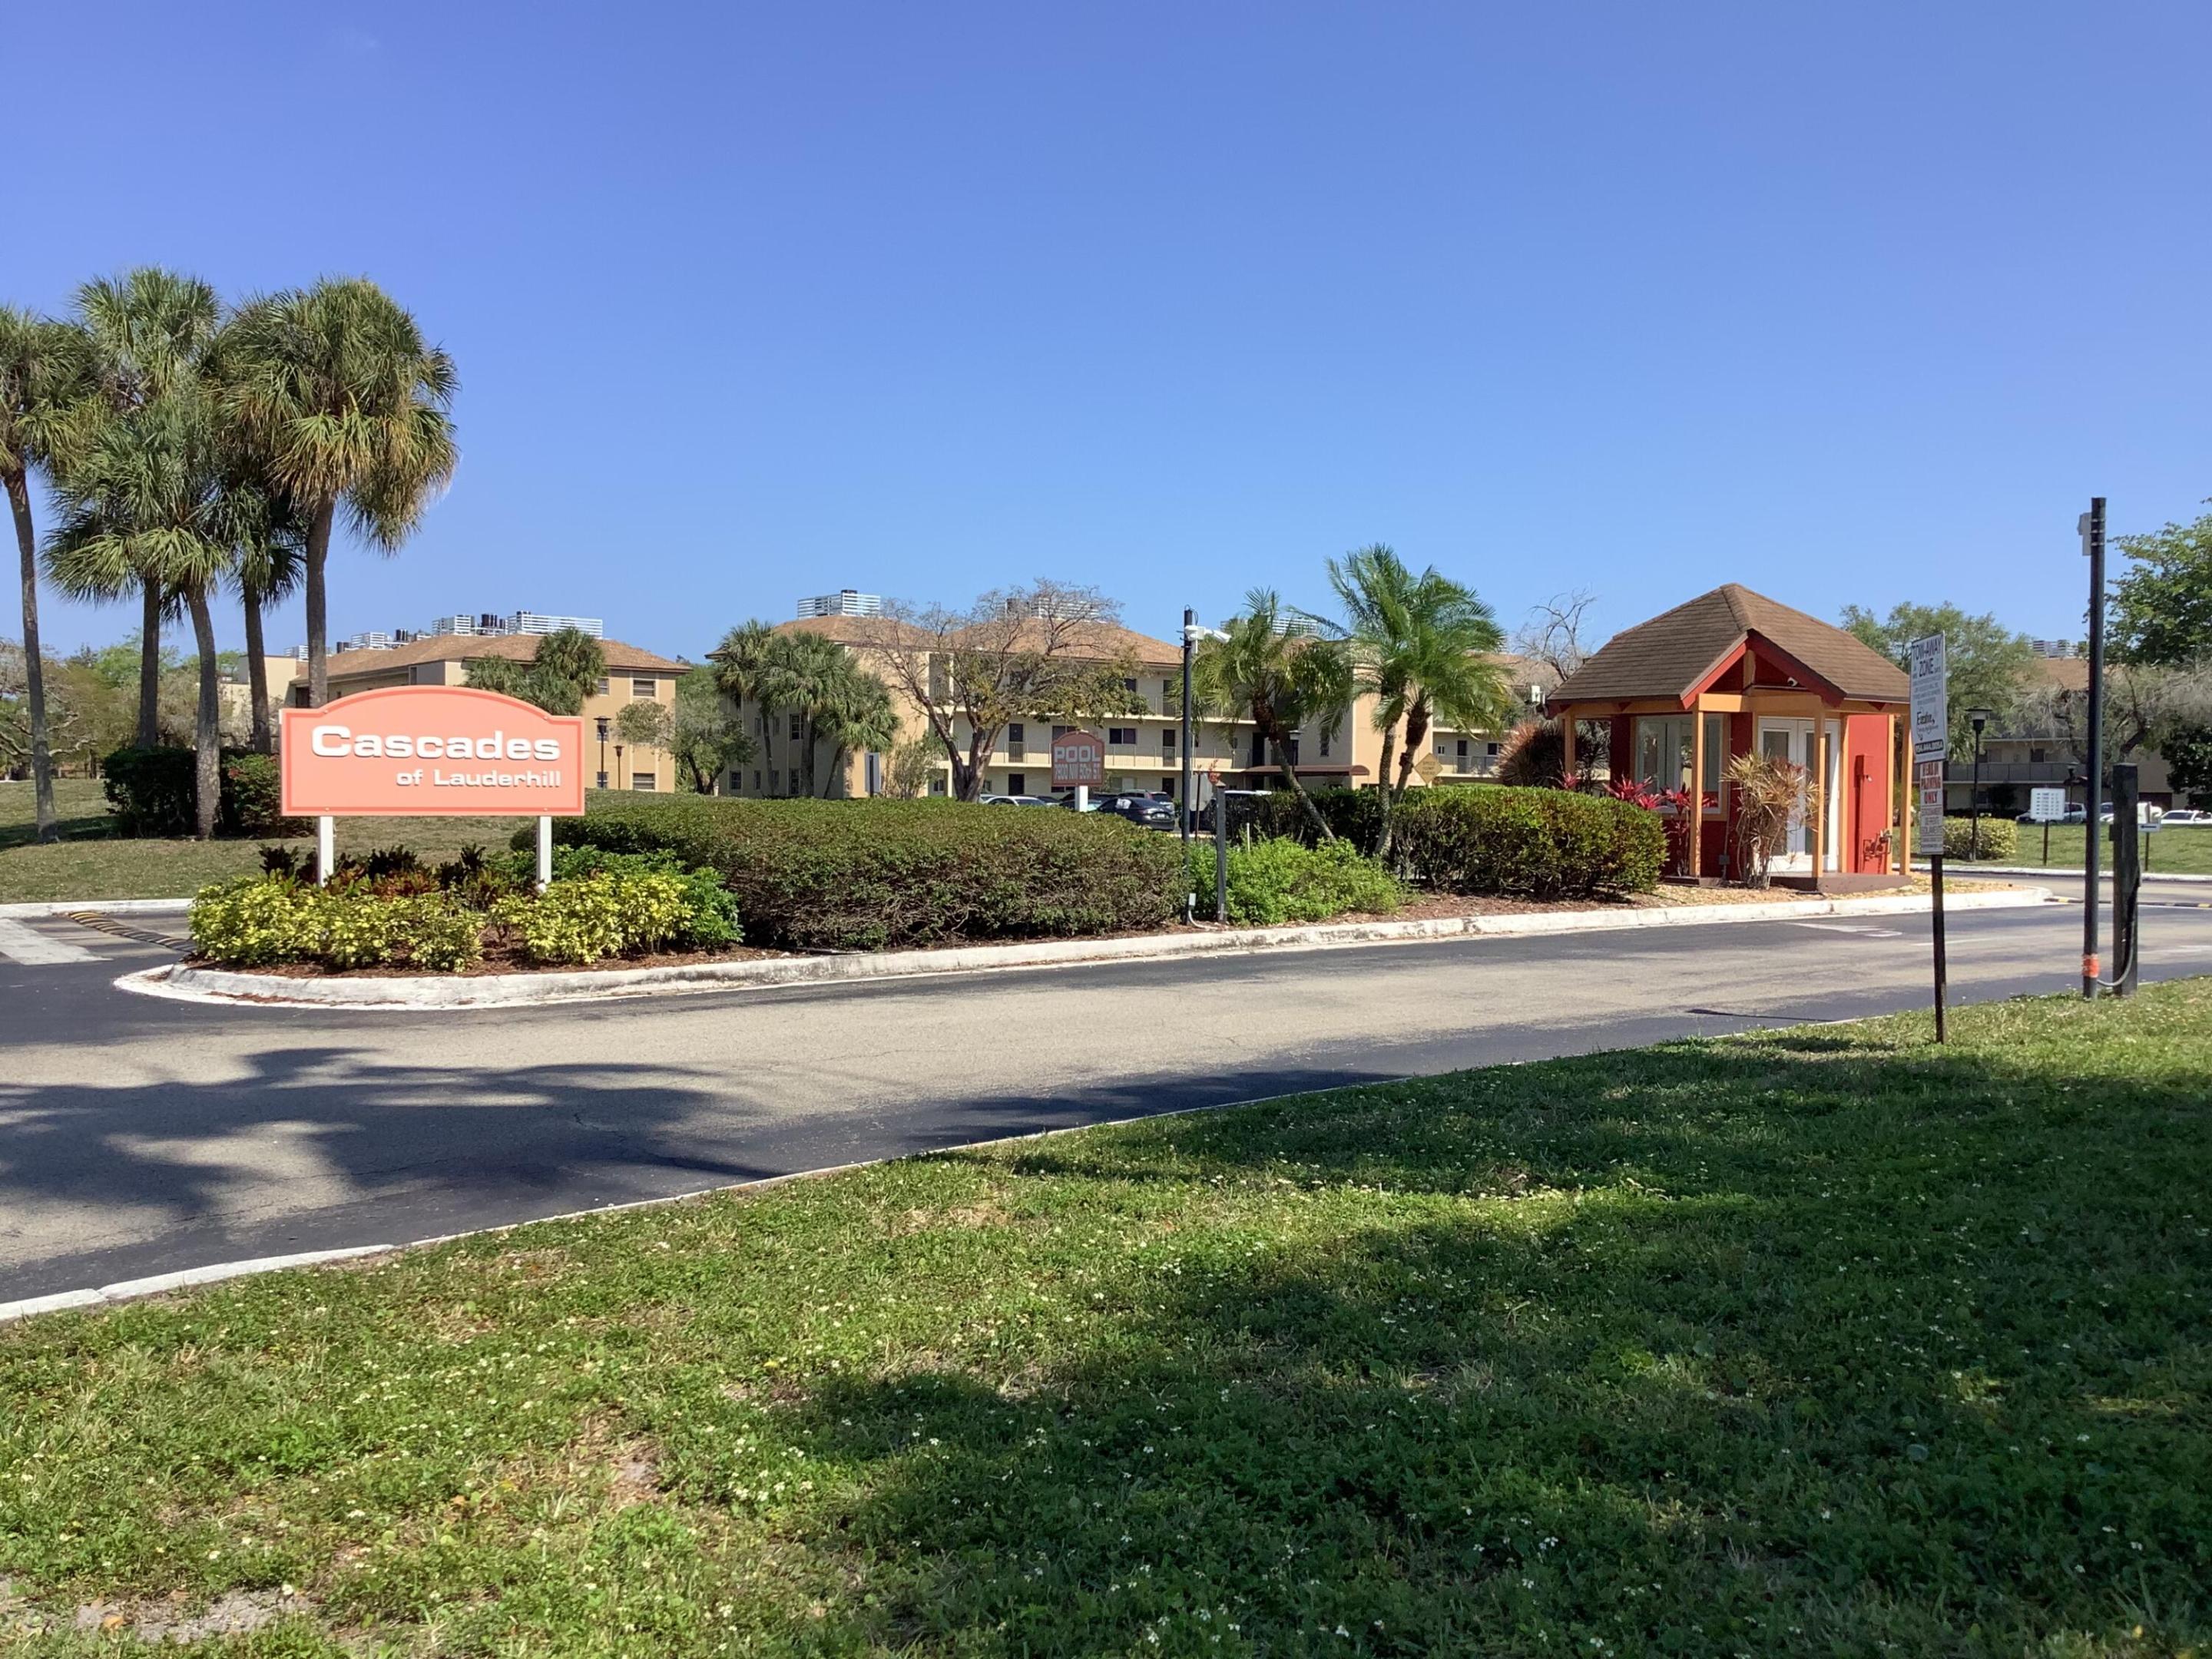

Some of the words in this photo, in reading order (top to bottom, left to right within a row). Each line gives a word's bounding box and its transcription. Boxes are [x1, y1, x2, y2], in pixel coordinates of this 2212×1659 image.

[1912, 638, 1942, 661] TOW-AWAY
[1919, 657, 1934, 677] ZONE
[312, 725, 561, 760] Cascades
[1055, 746, 1101, 763] POOL
[396, 769, 423, 786] of
[434, 769, 561, 787] Lauderhill
[1921, 776, 1941, 790] PARKING
[1924, 791, 1938, 804] ONLY
